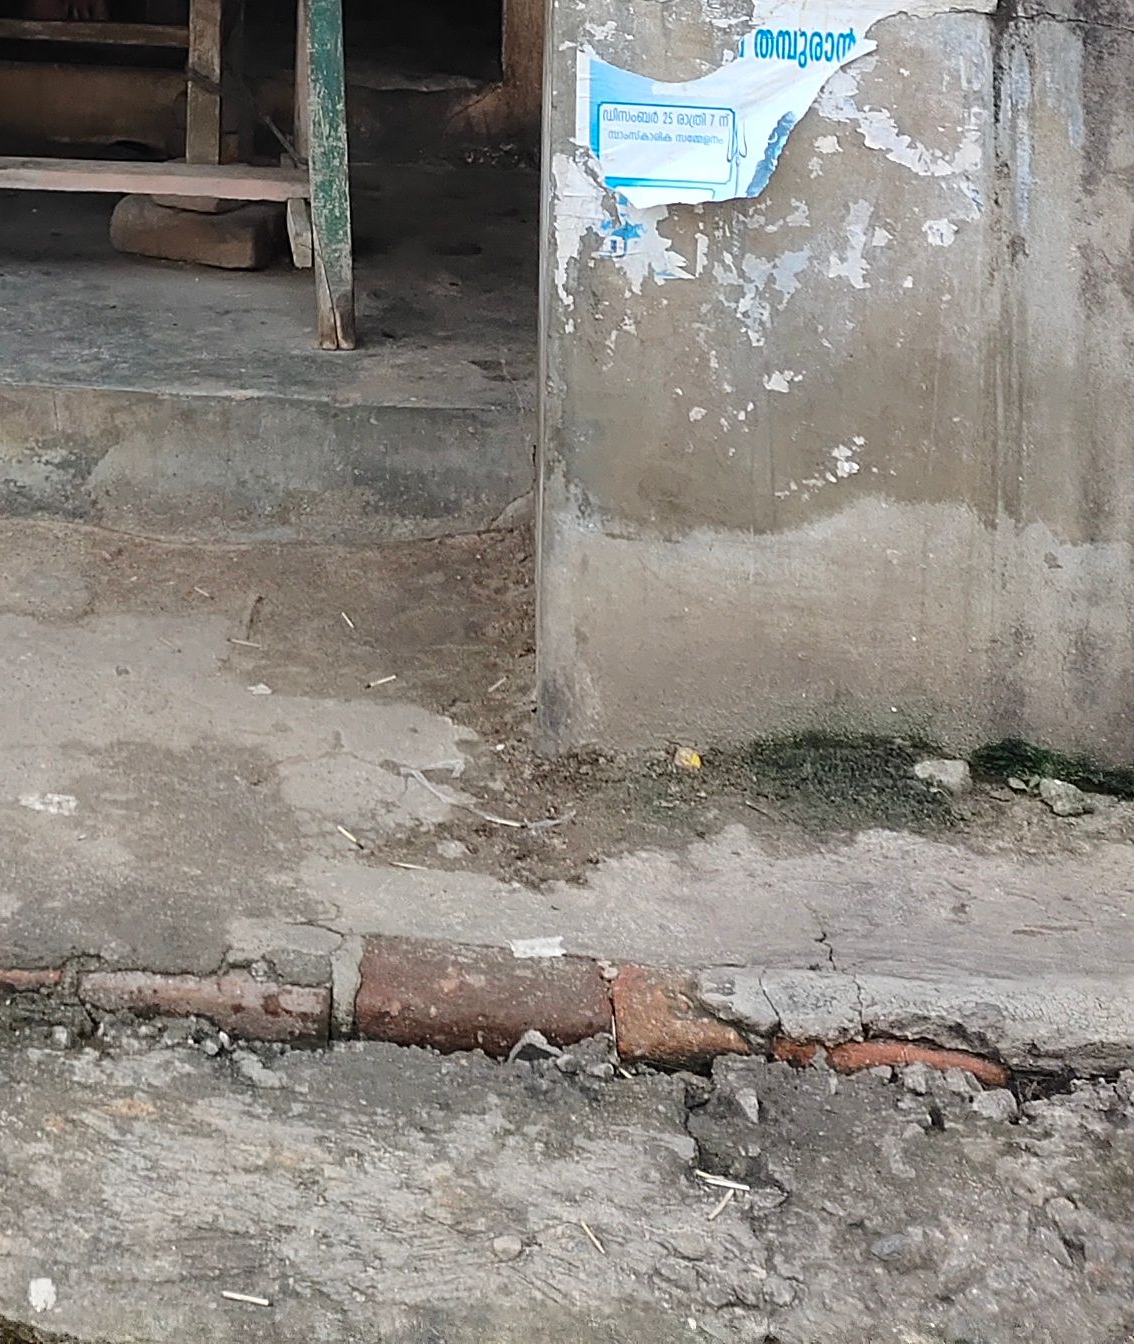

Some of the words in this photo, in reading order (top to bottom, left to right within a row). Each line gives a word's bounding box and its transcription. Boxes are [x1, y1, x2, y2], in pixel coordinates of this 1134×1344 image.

[754, 27, 857, 68] തമ്പുരാൻ
[603, 108, 659, 124] ഡിസംബർ
[662, 112, 673, 124] 25
[677, 112, 707, 128] രാത്രി
[710, 114, 715, 126] 7
